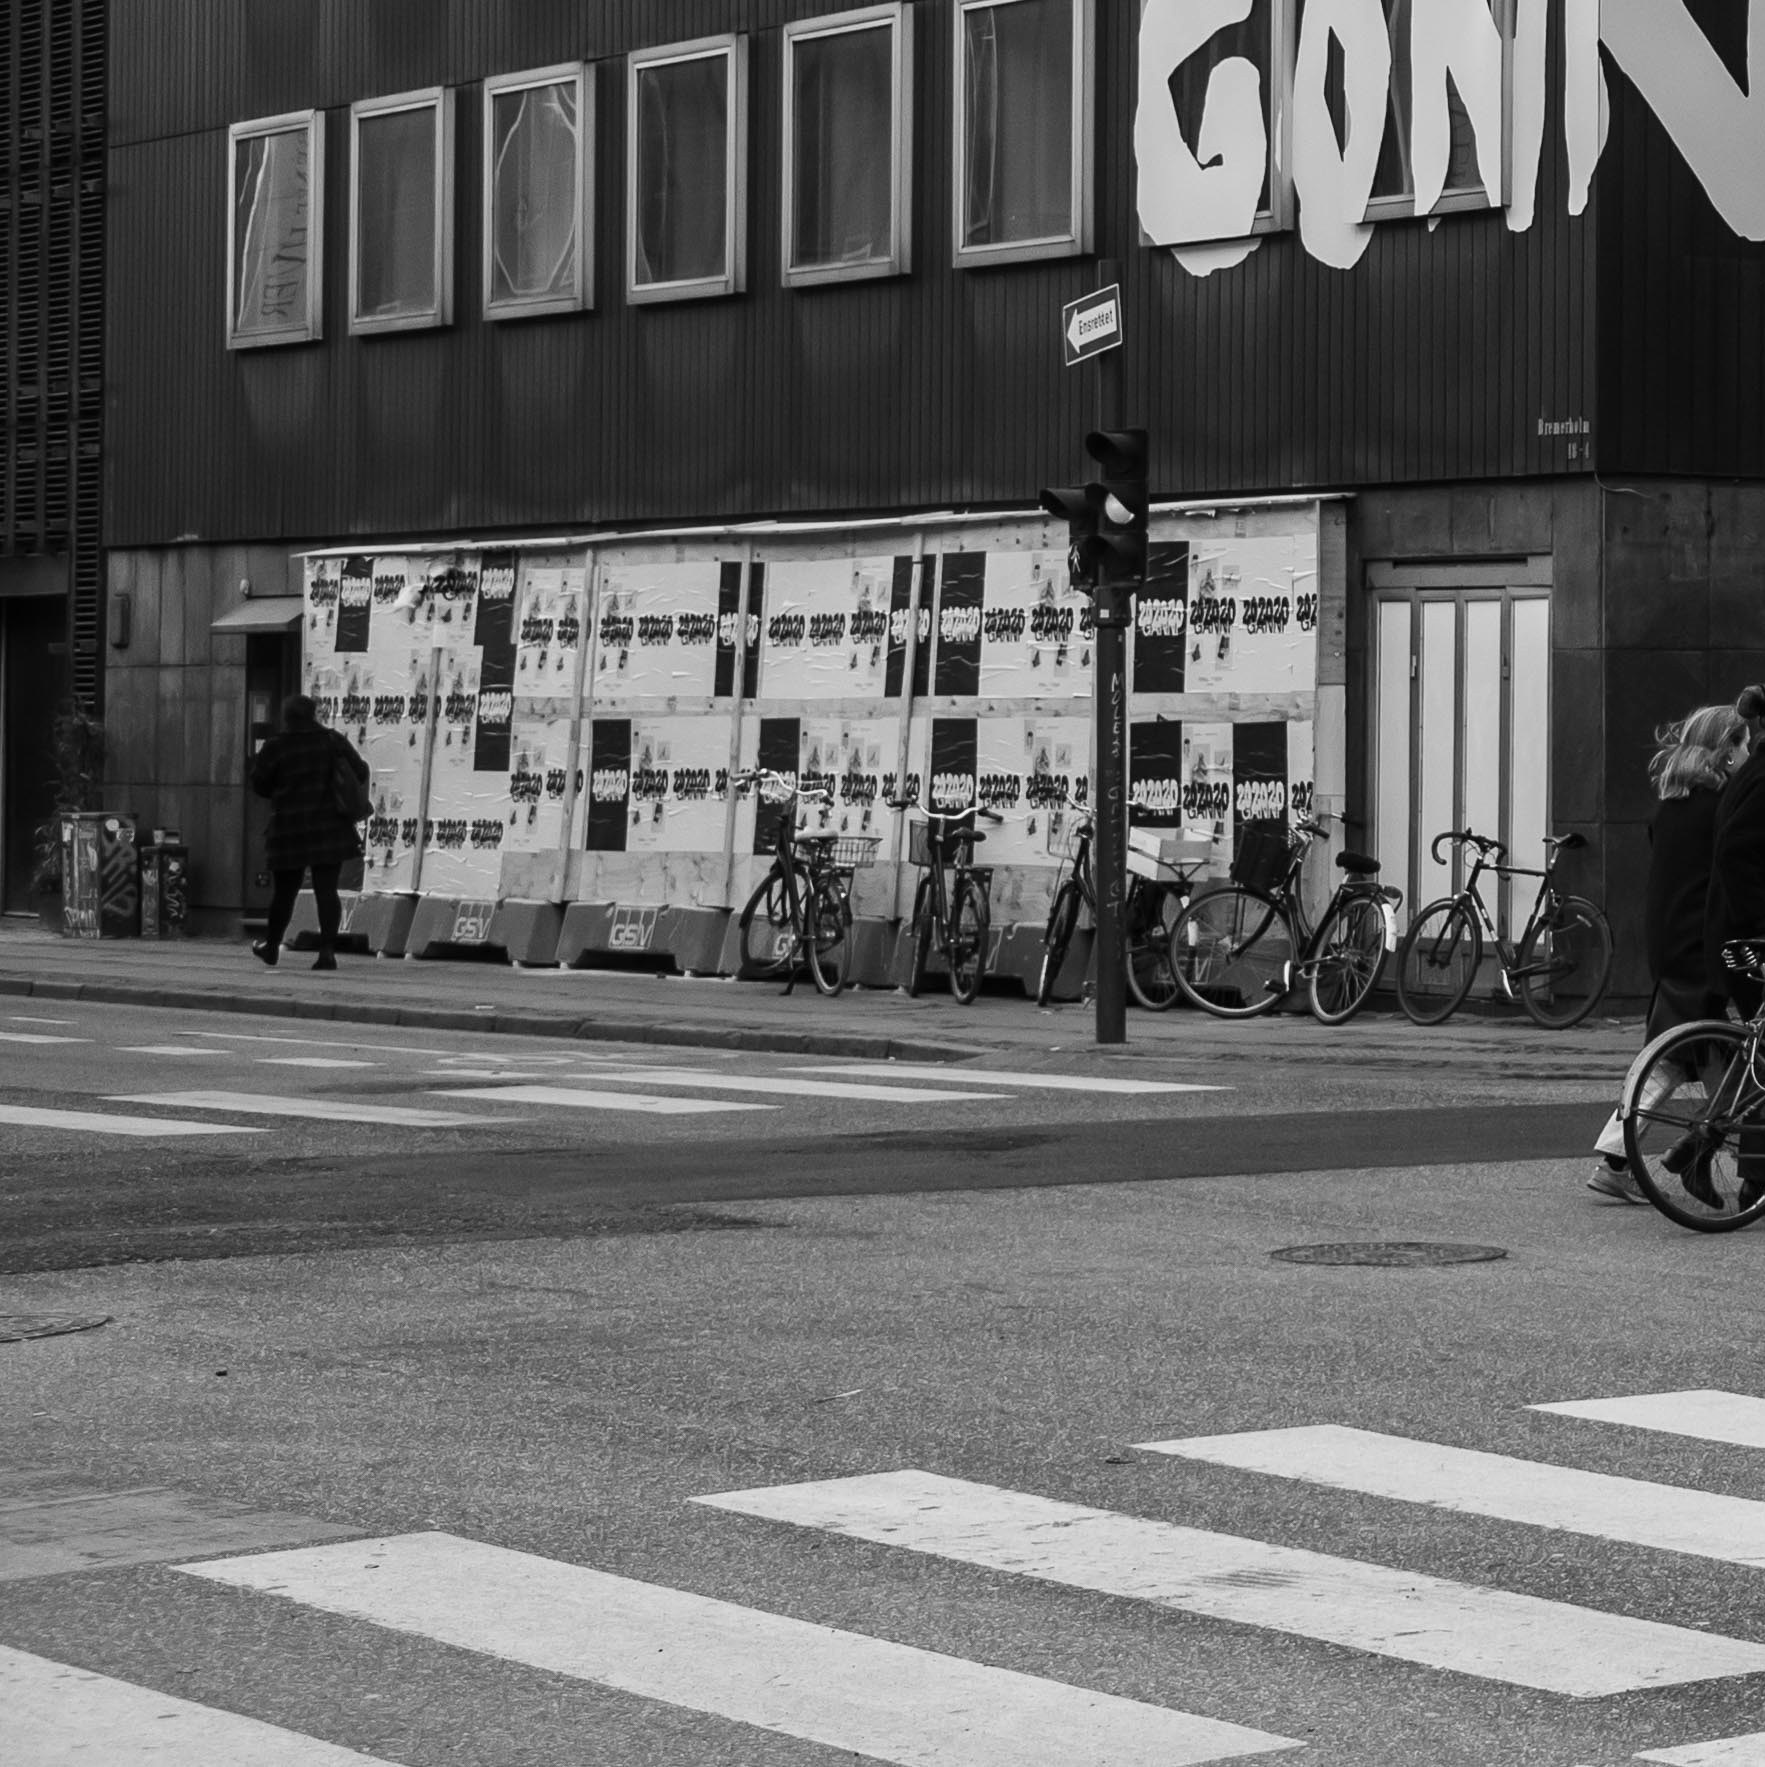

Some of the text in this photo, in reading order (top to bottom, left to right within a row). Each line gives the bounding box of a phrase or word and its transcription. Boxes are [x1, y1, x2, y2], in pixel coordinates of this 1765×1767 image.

[1078, 307, 1114, 336] Ensrettet
[1538, 416, 1590, 436] Bremerholm
[454, 916, 491, 939] GSV
[611, 924, 652, 946] GSV
